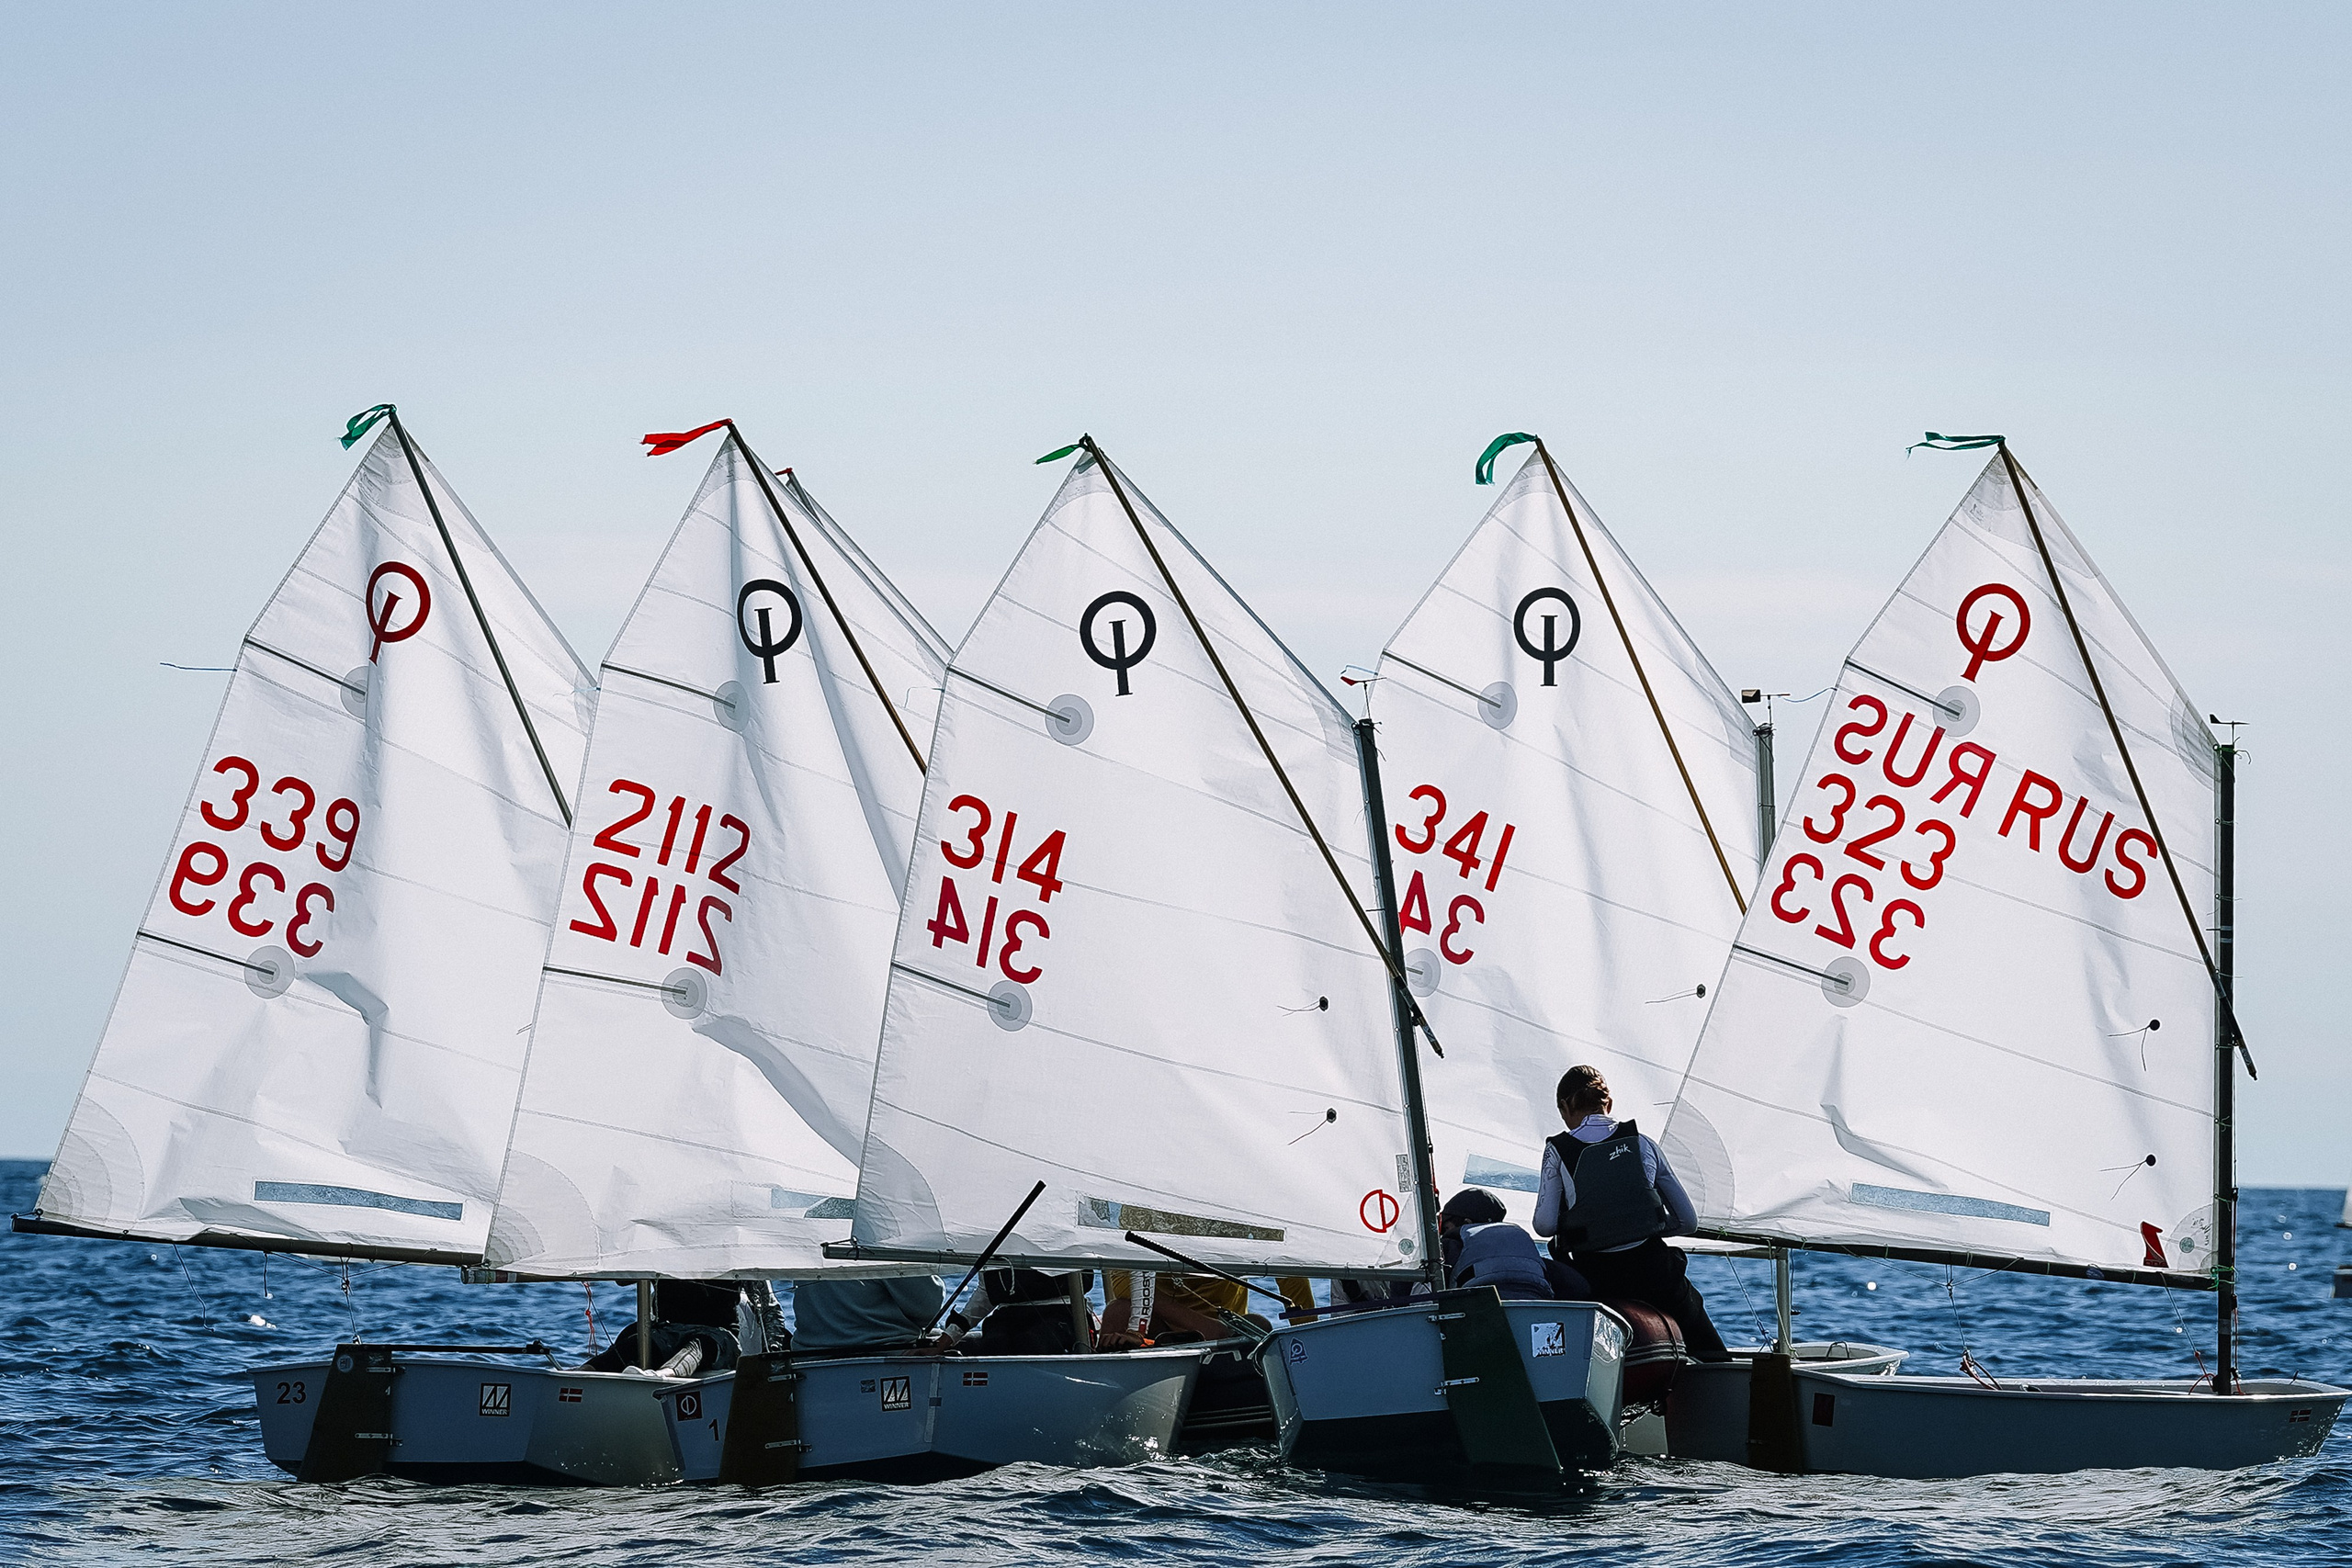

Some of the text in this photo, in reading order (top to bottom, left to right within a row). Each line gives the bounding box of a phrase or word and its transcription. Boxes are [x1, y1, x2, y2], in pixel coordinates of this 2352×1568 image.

[201, 756, 360, 872] 339
[594, 779, 751, 894] 2112
[941, 794, 1066, 904] 314
[1395, 784, 1516, 892] 341
[1803, 773, 1956, 891] 323
[1997, 769, 2158, 900] RUS
[1609, 1144, 1632, 1161] zhik
[277, 1382, 307, 1404] 23
[708, 1418, 719, 1441] 1
[884, 1402, 910, 1410] WINNER
